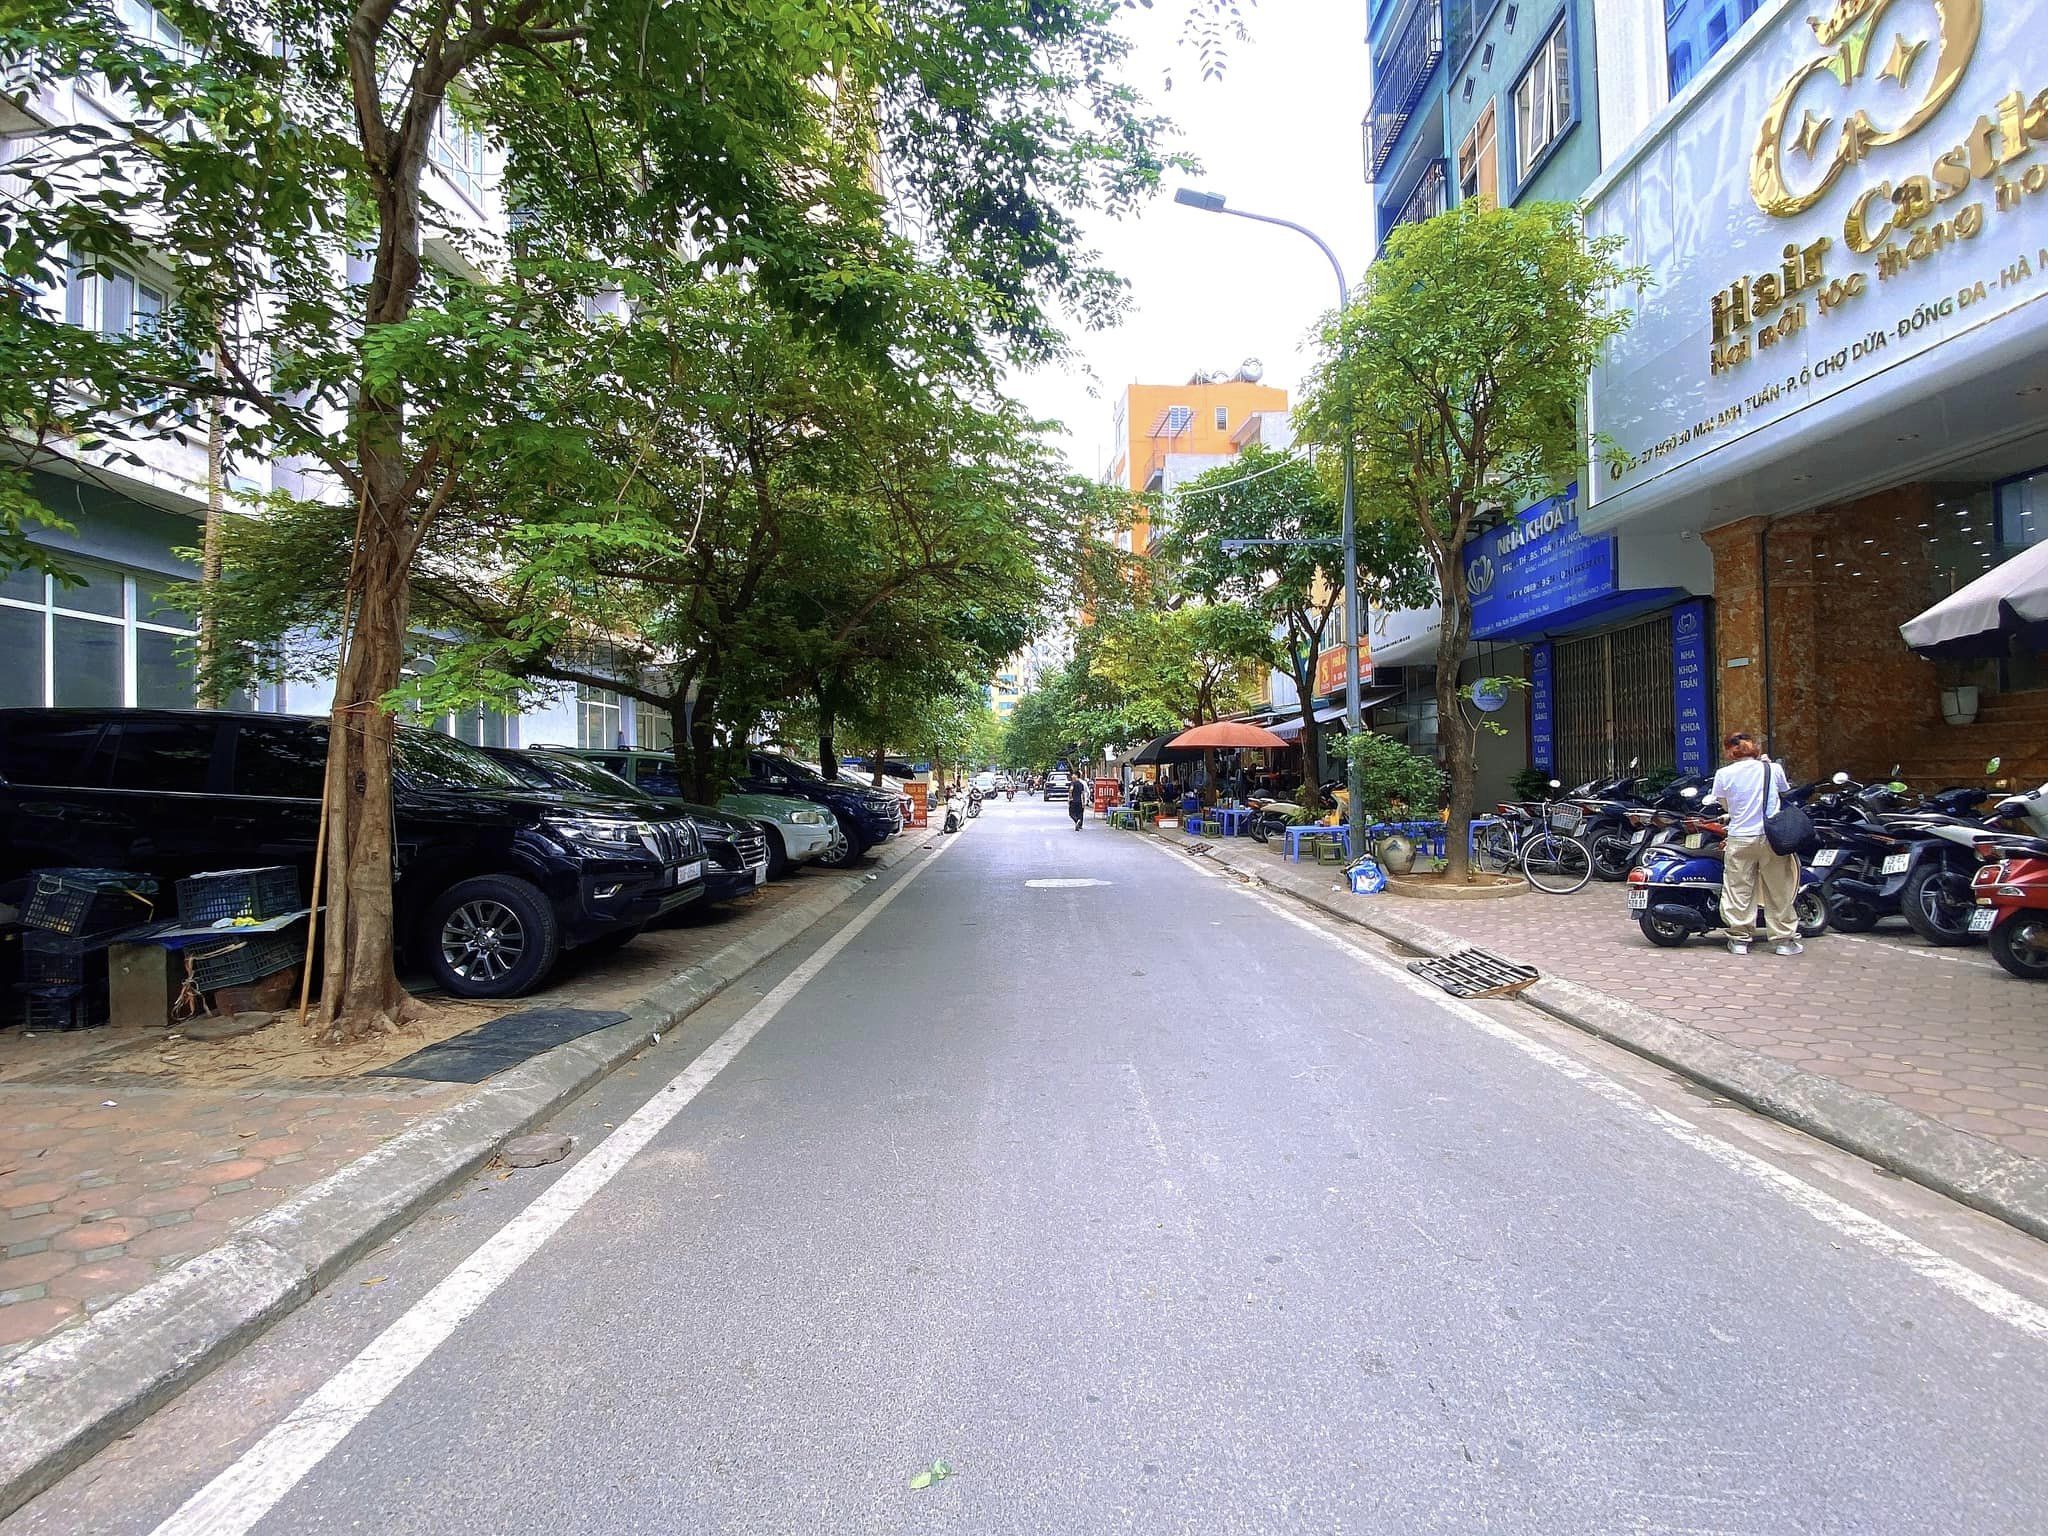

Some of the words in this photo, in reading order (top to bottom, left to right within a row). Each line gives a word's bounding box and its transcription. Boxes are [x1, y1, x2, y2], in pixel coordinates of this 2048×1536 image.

[1710, 236, 1832, 345] Hair
[1814, 347, 1848, 378] CHỢ
[1678, 663, 1698, 675] KHOA
[1680, 721, 1700, 732] KHOA
